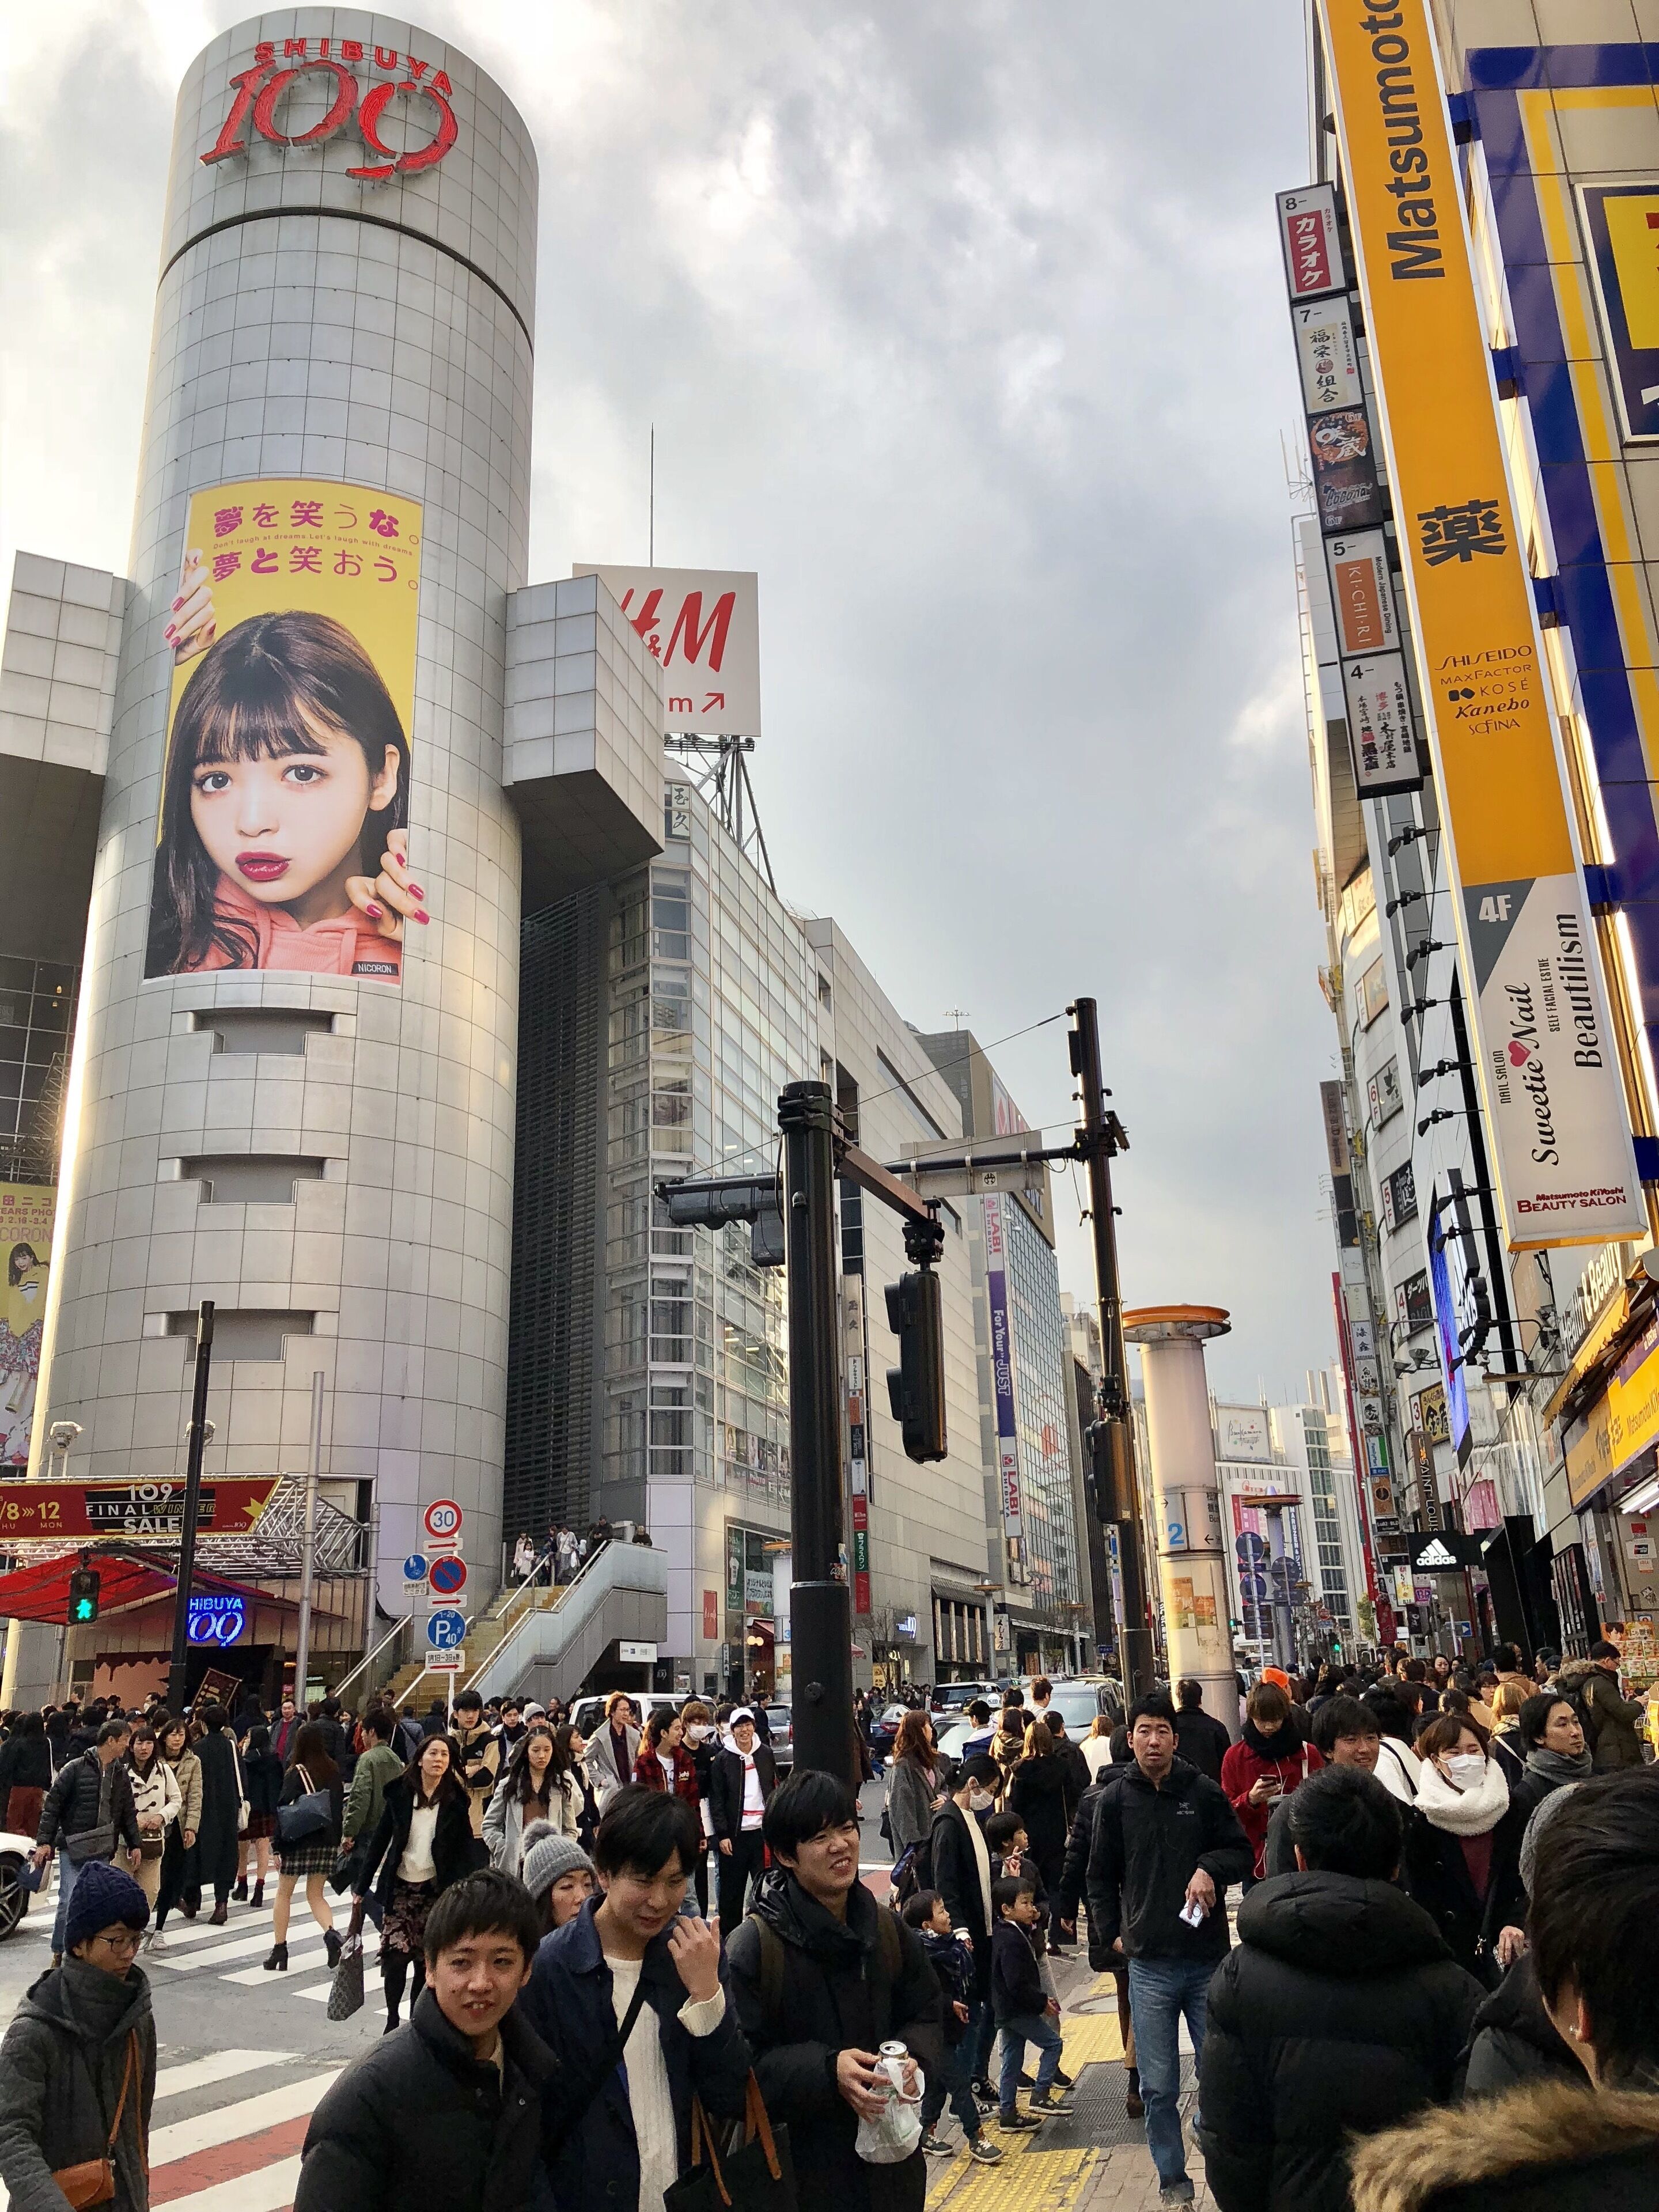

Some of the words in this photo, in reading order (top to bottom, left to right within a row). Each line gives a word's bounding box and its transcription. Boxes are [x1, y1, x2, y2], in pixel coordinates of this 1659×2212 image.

[254, 38, 453, 96] SHIBUYA
[200, 59, 459, 179] 109
[1325, 209, 1334, 233] カラオケ
[1296, 216, 1324, 288] カラオケ
[214, 500, 420, 546] 夢を笑うな。
[1416, 499, 1508, 567] 薬
[213, 539, 234, 549] Don't
[237, 536, 259, 544] laugh
[334, 535, 358, 544] laugh
[362, 539, 380, 548] with
[212, 546, 419, 590] 夢と笑おう。
[1375, 556, 1384, 581] Modern
[1378, 581, 1389, 612] Japanese
[1384, 612, 1392, 634] Dining
[1434, 645, 1532, 672] SHISEIDO
[1480, 677, 1530, 696] KOSÉ
[668, 697, 693, 713] m
[1455, 698, 1530, 719] Kanebo
[1468, 719, 1521, 735] SOFINA
[673, 787, 690, 832] 玉久
[1478, 893, 1512, 923] 4F
[358, 964, 392, 974] NICORON
[1537, 957, 1552, 982] ESTHE
[1543, 983, 1558, 1012] FACIAL
[1556, 914, 1603, 1068] Beautilism
[1503, 982, 1540, 1050] Nail
[1548, 1013, 1560, 1033] SELF
[1493, 1050, 1509, 1080] SALON
[1500, 1082, 1512, 1104] NAIL
[1522, 1059, 1559, 1166] Sweetie
[1384, 1187, 1392, 1222] 5F
[1517, 1199, 1577, 1214] BEAUTY
[1579, 1195, 1627, 1208] SALON
[1536, 1191, 1589, 1202] Matsumoto
[0, 1207, 28, 1215] EARS
[991, 1213, 1002, 1255] LABI
[1560, 1287, 1586, 1355] Health
[1581, 1271, 1592, 1322] &
[1588, 1242, 1623, 1313] Beauty
[994, 1309, 1004, 1327] For
[995, 1327, 1006, 1353] Your
[1627, 1400, 1652, 1438] Matsumoto
[1419, 1458, 1433, 1494] SAINT
[127, 1483, 173, 1501] 109
[1007, 1471, 1020, 1517] LABI
[37, 1501, 60, 1520] 12
[86, 1504, 150, 1516] FINAL
[153, 1503, 217, 1514] WINER
[433, 1510, 454, 1528] 30
[123, 1517, 180, 1534] SALE
[1168, 1522, 1184, 1545] 2
[1290, 1505, 1300, 1548] MARUZEN
[1416, 1555, 1457, 1566] adidas
[190, 1597, 243, 1611] HIBUYA
[188, 1611, 243, 1647] 09
[435, 1620, 450, 1645] P
[445, 1633, 457, 1645] 40
